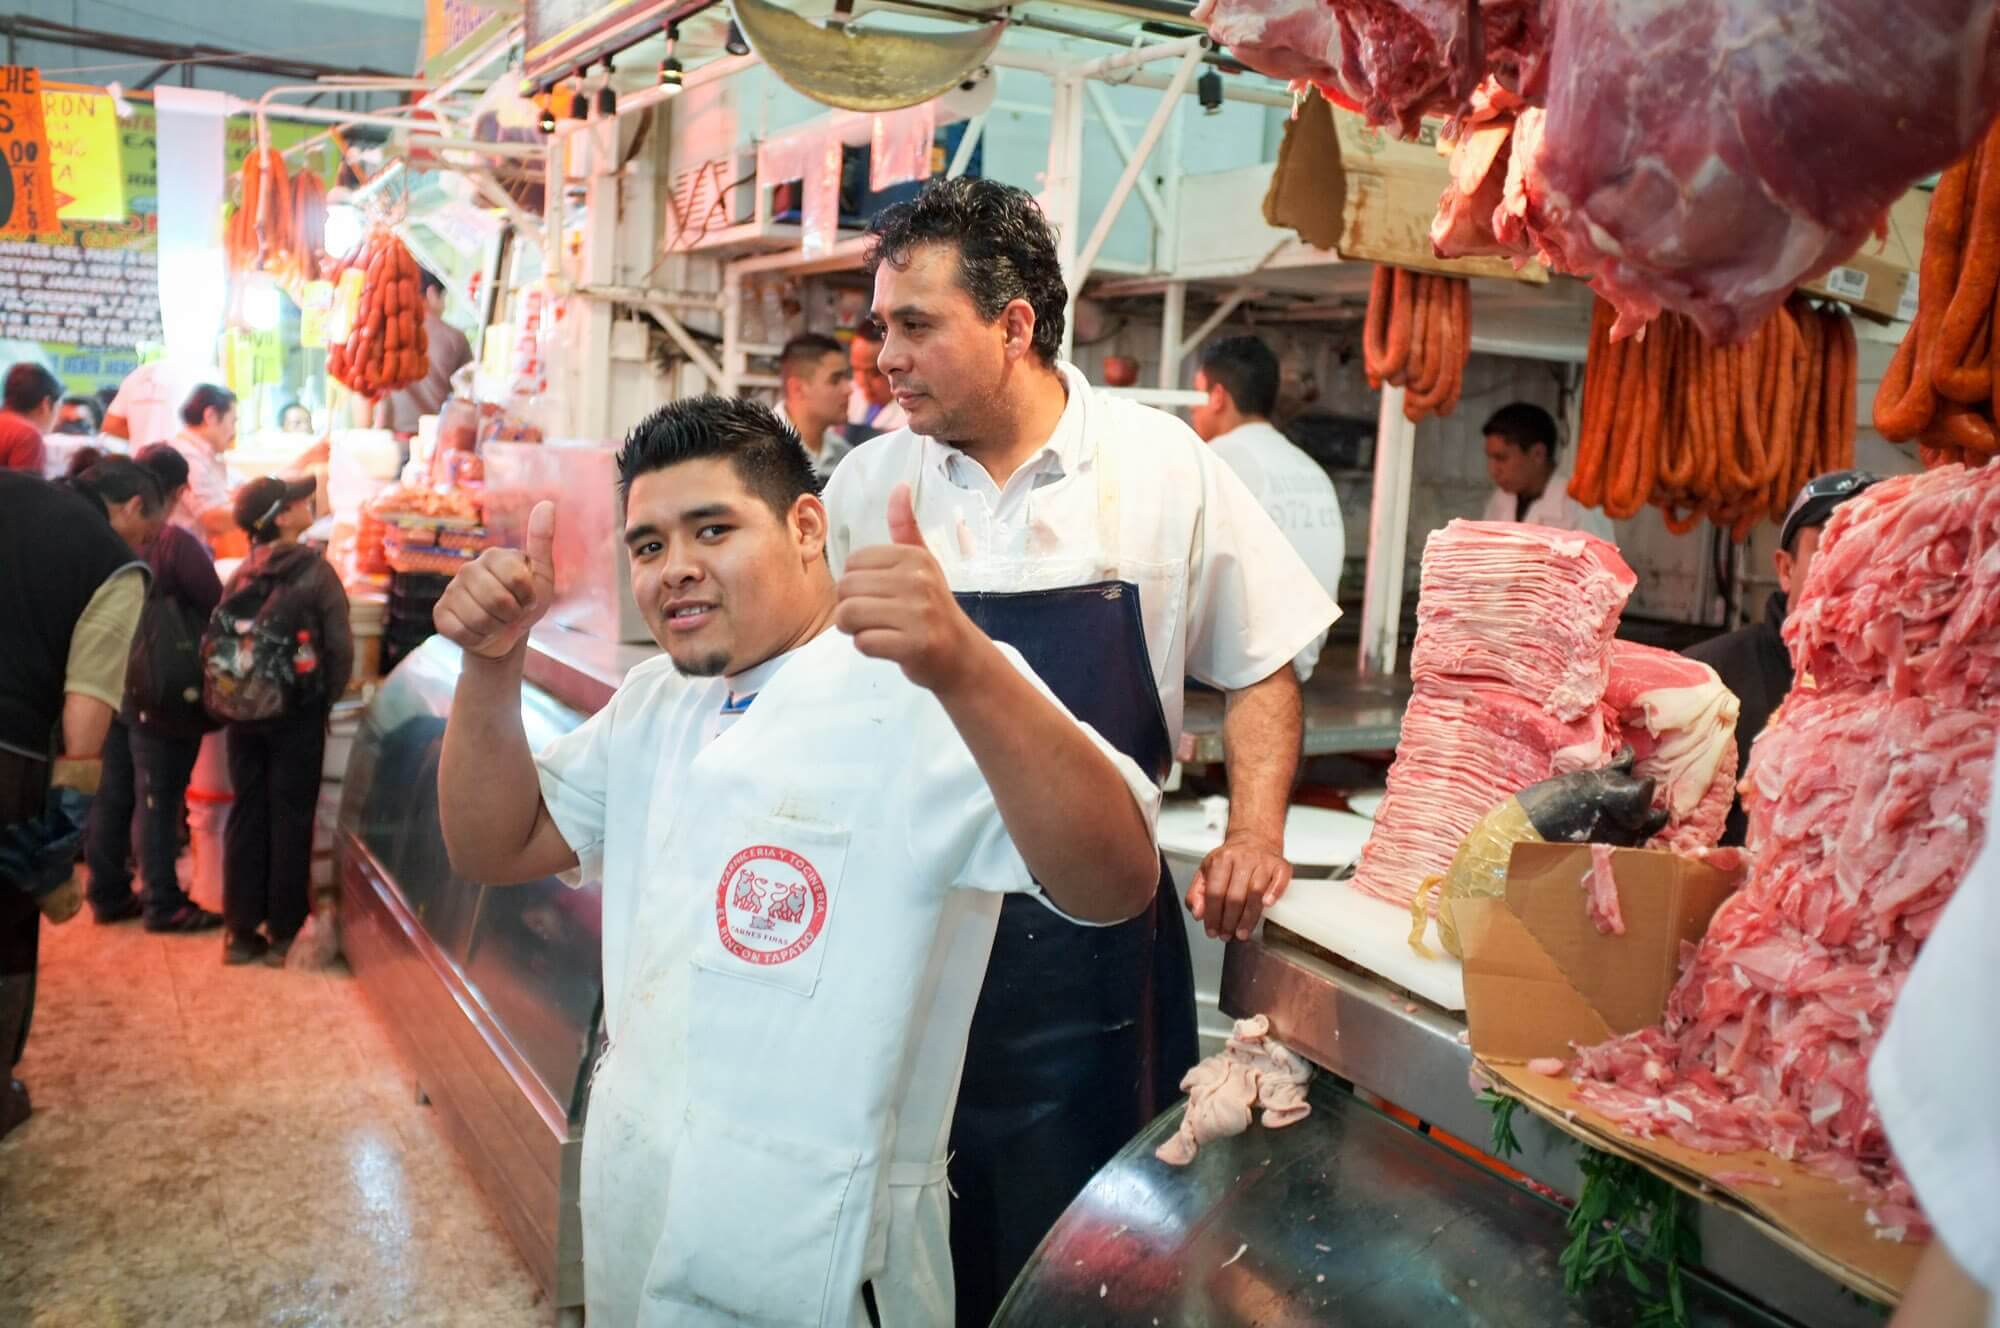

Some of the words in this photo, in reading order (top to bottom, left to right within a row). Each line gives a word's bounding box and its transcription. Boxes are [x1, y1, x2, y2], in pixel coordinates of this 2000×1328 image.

[721, 848, 776, 886] CARNICERIA
[779, 850, 788, 860] Y
[790, 856, 825, 912] TOCINERIA
[720, 926, 760, 961] RINCON
[765, 931, 814, 962] TAPATIO
[731, 926, 762, 939] CARNES
[763, 934, 789, 945] FINAS
